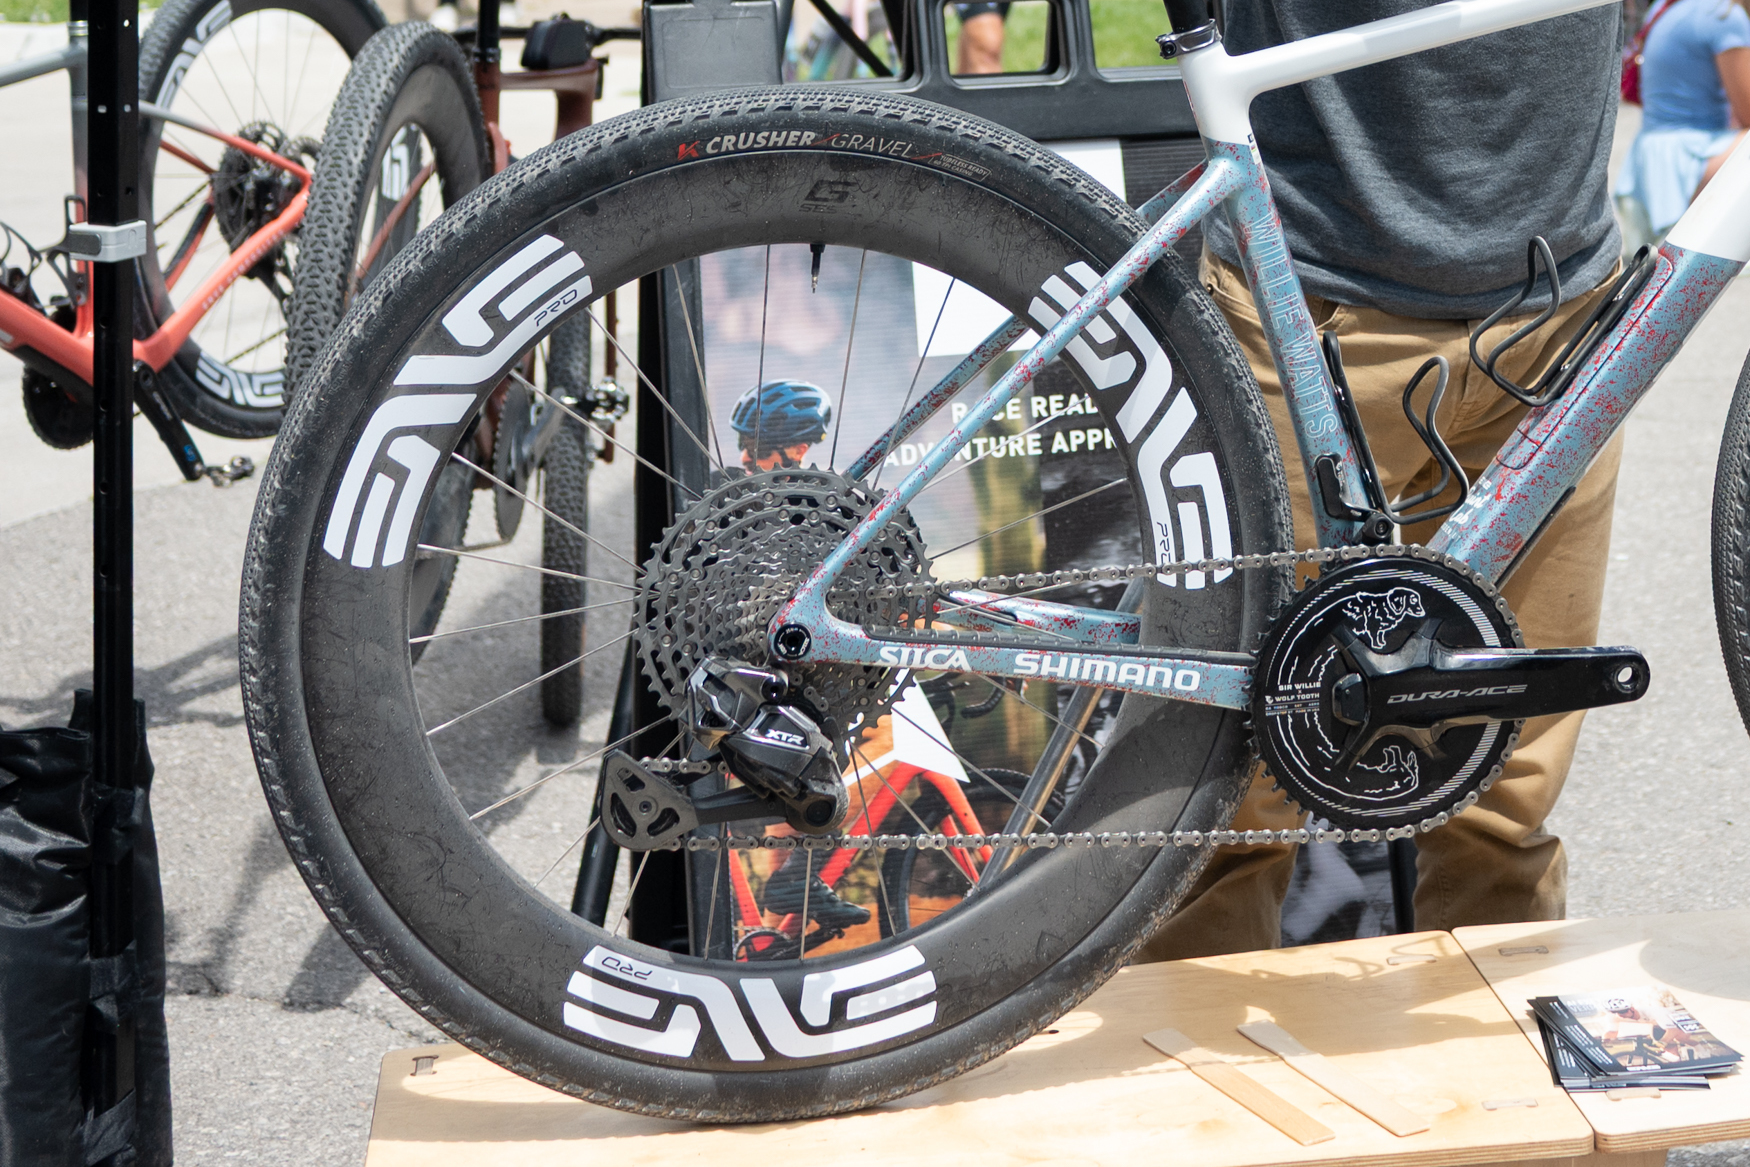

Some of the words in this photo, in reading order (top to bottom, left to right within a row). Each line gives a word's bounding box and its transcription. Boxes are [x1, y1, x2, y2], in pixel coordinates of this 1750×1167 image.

[705, 131, 816, 154] CRUSHER
[831, 134, 912, 160] GRAVEL
[533, 288, 579, 328] PRO
[1244, 212, 1304, 330] WILLIE
[1280, 331, 1339, 440] WATTS
[952, 402, 1021, 425] RE
[884, 433, 1042, 468] ADVNTURE
[877, 646, 972, 672] SILCA
[1013, 652, 1201, 692] SHIMANO
[1294, 682, 1321, 690] WILLIE
[1387, 684, 1528, 704] DURA-ACE
[765, 729, 804, 745] XTR
[600, 957, 652, 981] PRO
